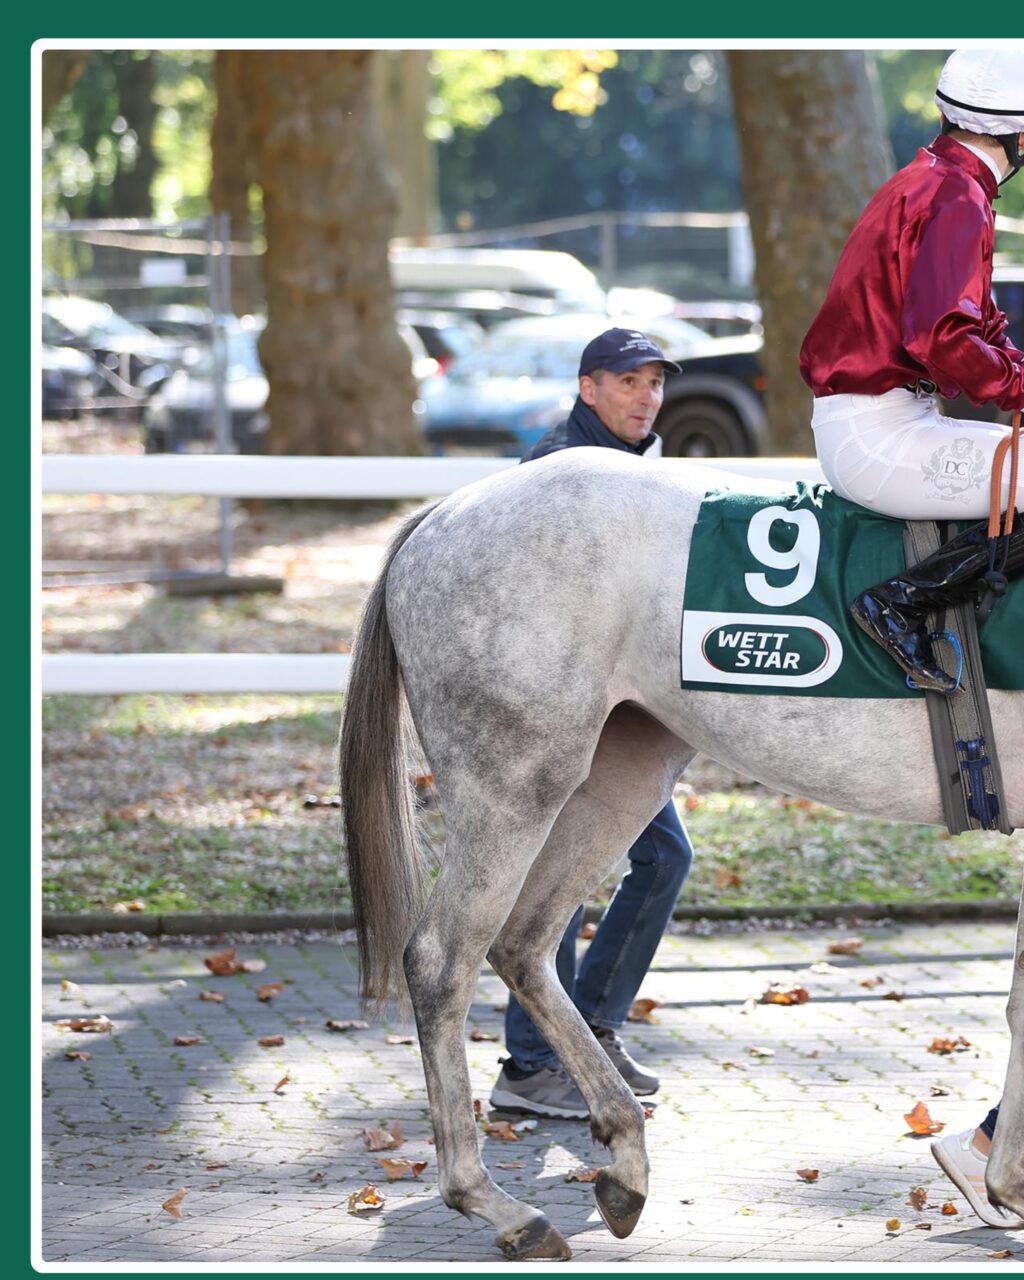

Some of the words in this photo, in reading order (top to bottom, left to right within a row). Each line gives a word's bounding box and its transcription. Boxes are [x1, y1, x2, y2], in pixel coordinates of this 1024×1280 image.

[944, 460, 968, 476] DC
[744, 505, 821, 607] 9
[717, 630, 790, 650] WETT
[735, 649, 801, 670] STAR
